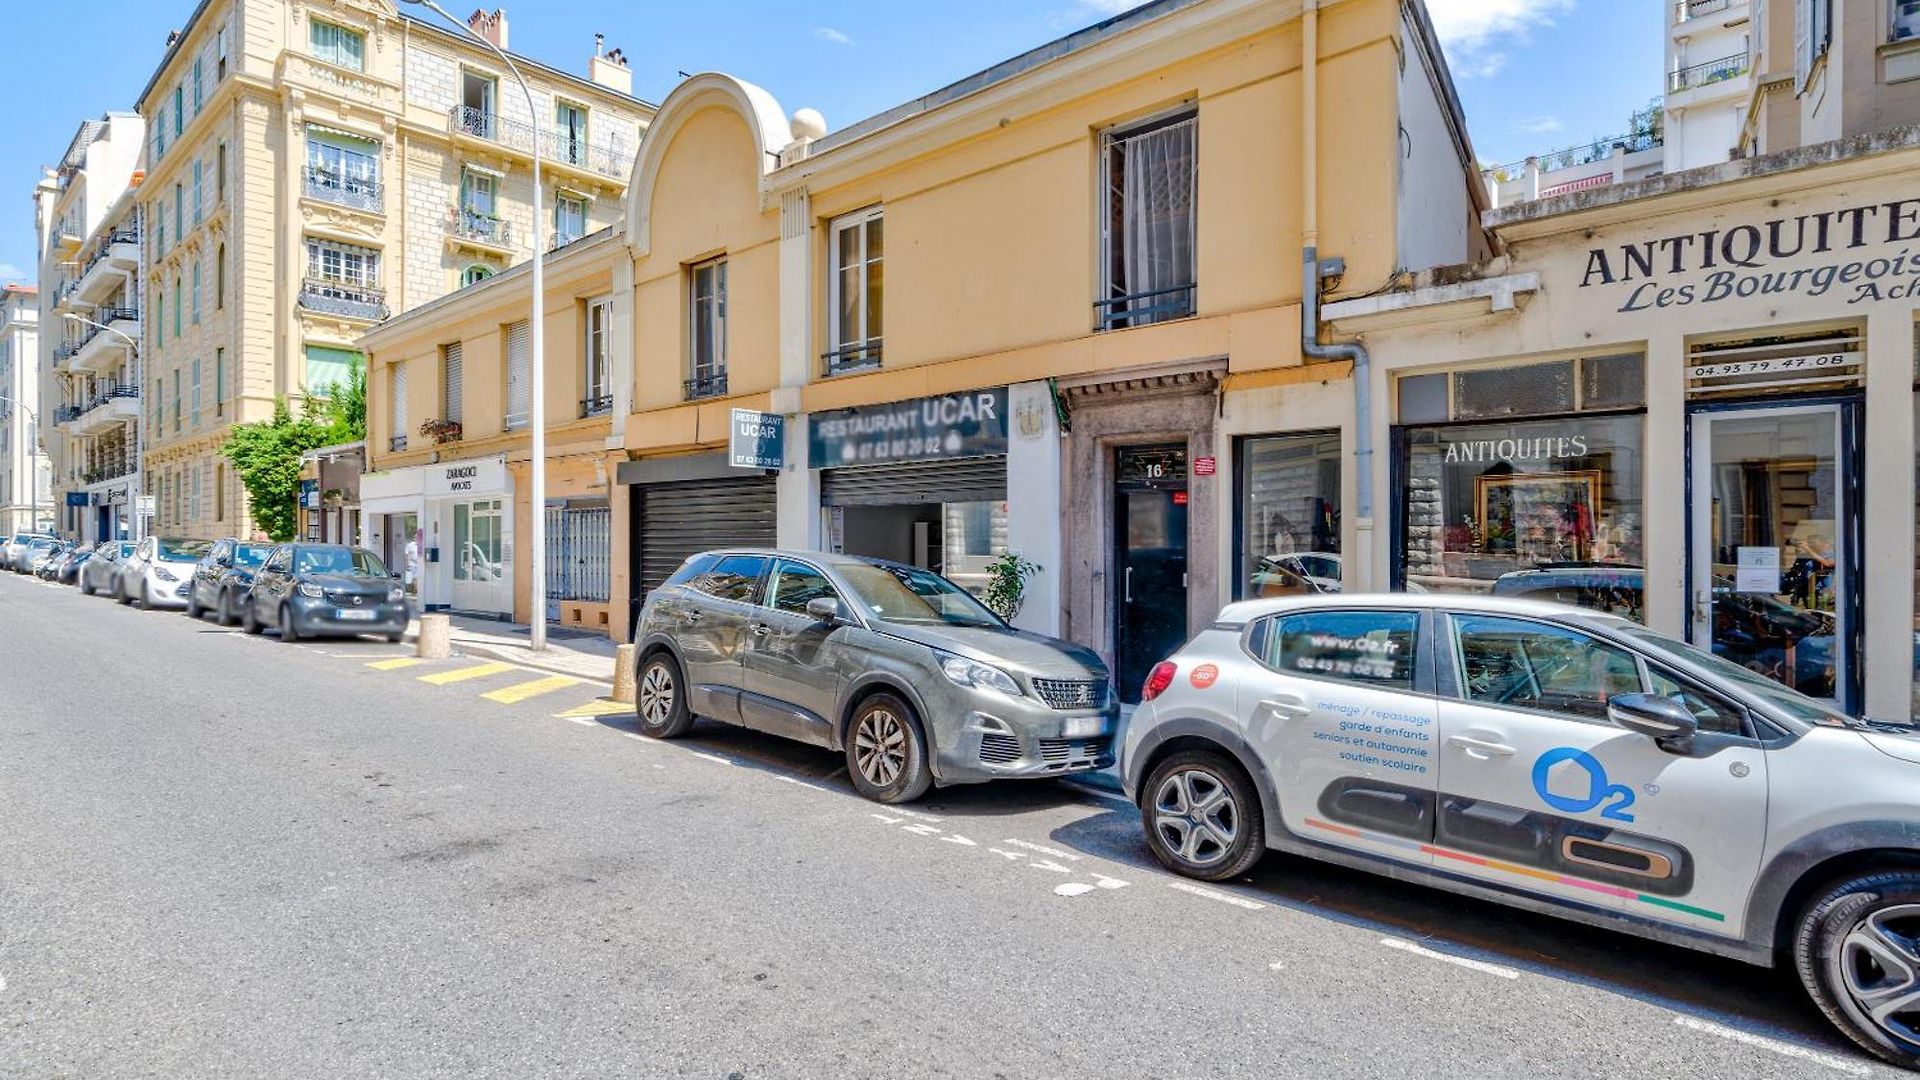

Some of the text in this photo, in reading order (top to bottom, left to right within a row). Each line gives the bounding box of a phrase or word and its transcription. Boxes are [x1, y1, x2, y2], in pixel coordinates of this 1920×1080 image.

[1579, 199, 1920, 287] ANTIQUITE
[1618, 248, 1920, 312] Les Bourgeois
[735, 411, 782, 439] RESTAURANT UCAR
[819, 394, 997, 439] RESTAURANT UCAR
[1444, 435, 1588, 463] ANTIQUITES
[1146, 463, 1163, 478] 16
[1317, 701, 1360, 716] ménage
[1371, 709, 1431, 726] repassage
[1339, 720, 1372, 732] garde
[1313, 732, 1428, 757] seniors et autonomie
[1340, 751, 1426, 774] soutien scolaire
